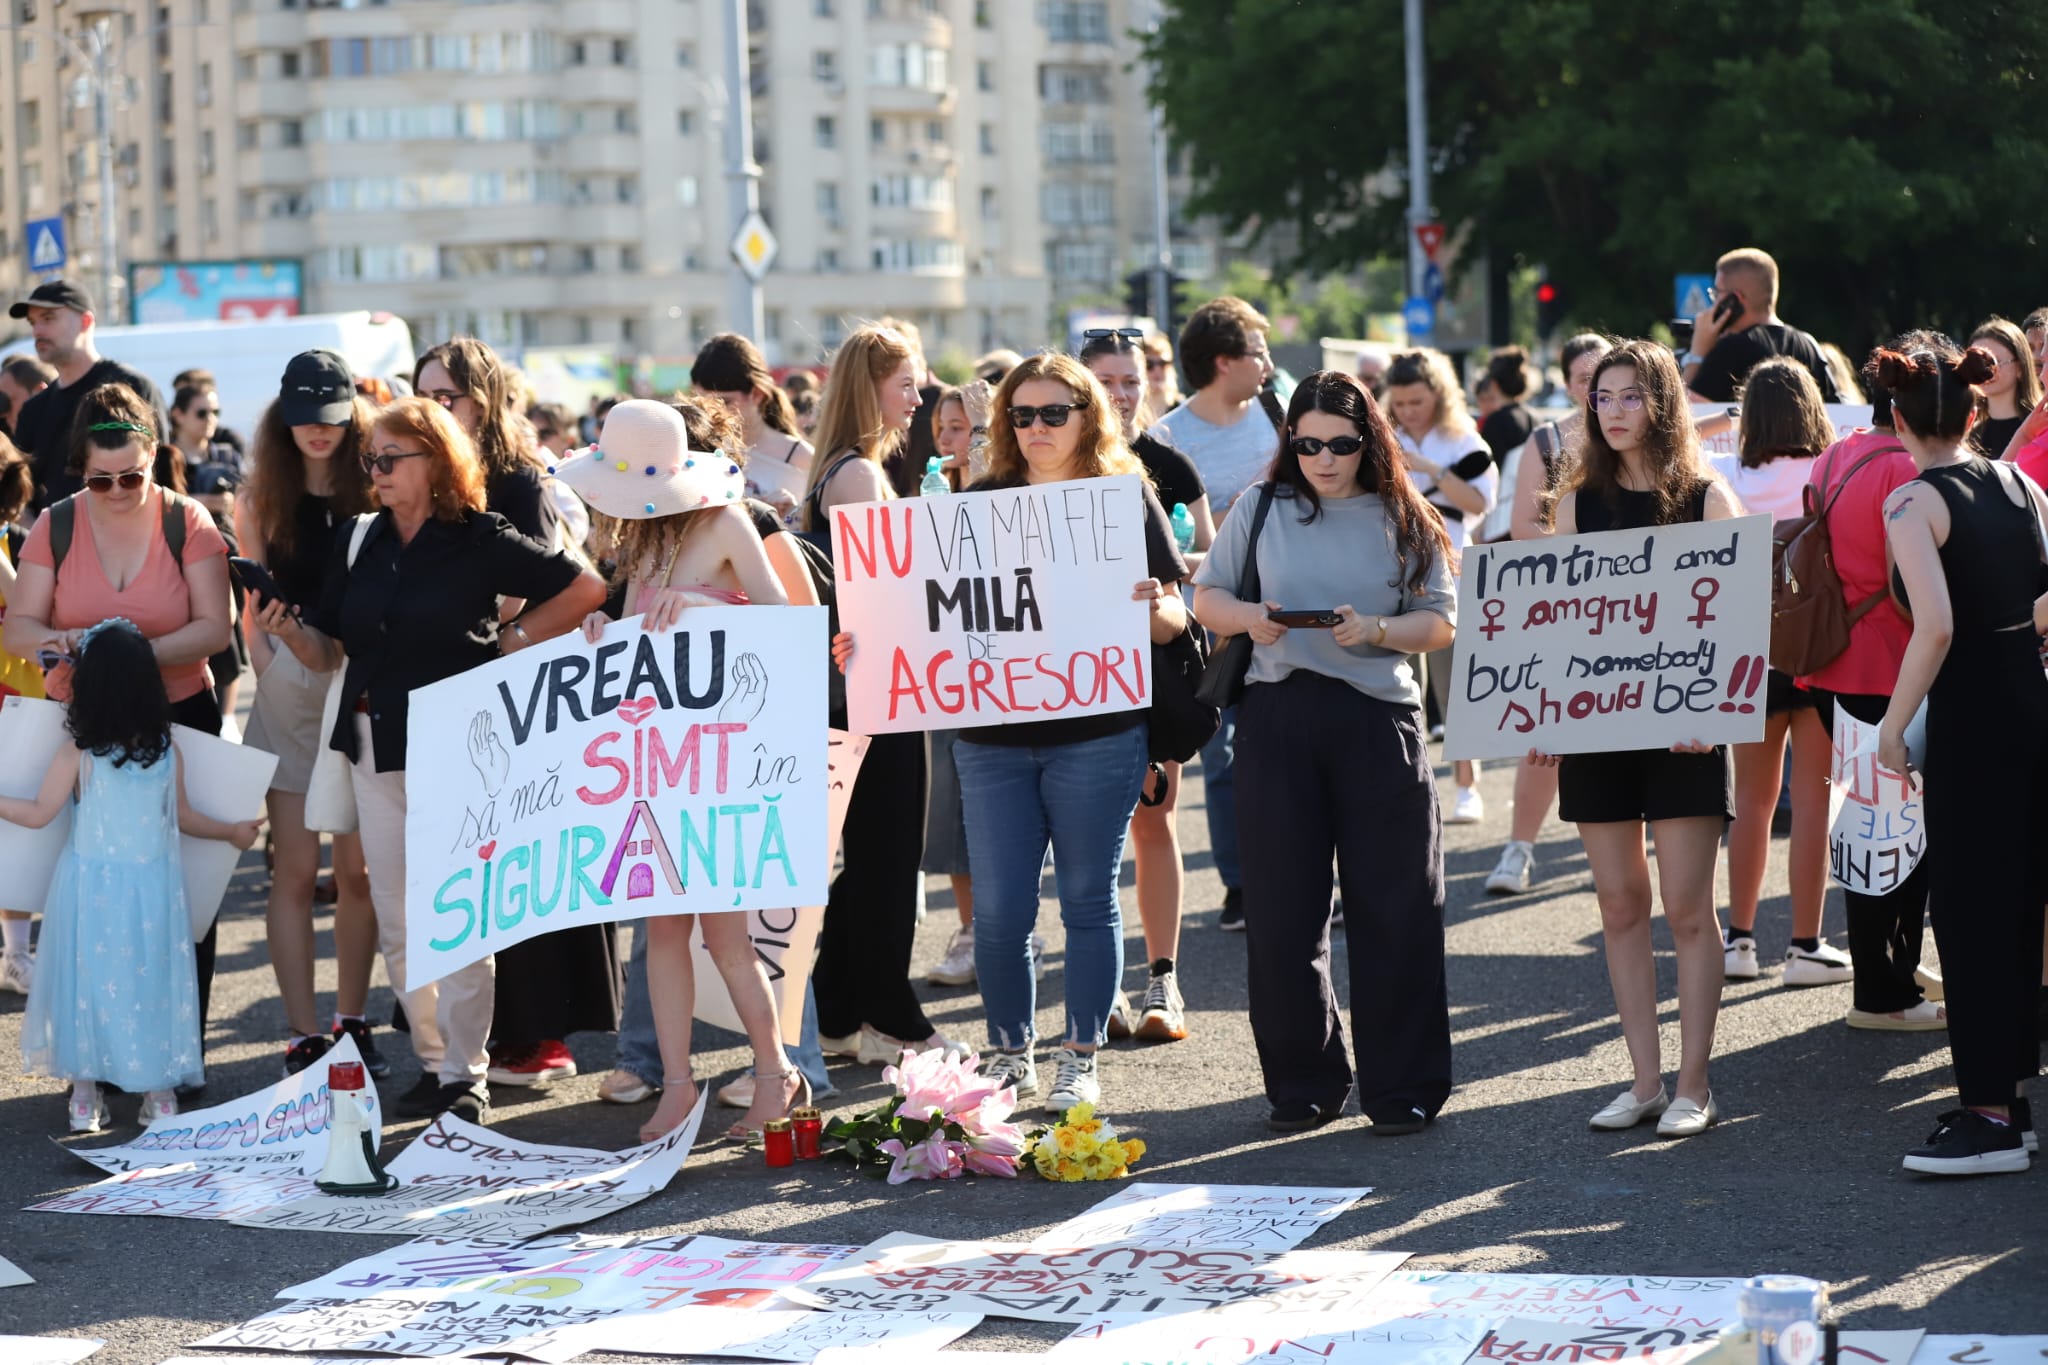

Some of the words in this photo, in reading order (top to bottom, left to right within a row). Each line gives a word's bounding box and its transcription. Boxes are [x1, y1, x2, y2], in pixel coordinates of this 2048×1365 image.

[837, 506, 912, 581] NU
[926, 501, 981, 572] VĂ
[990, 494, 1055, 567] MAI
[1063, 488, 1123, 565] FIE
[1562, 536, 1654, 586] tired
[1674, 532, 1739, 571] and
[925, 567, 1043, 632] MILĂ
[1522, 592, 1658, 635] angry
[966, 633, 1004, 661] DE
[1467, 653, 1542, 702] but
[1566, 639, 1716, 678] somebody
[497, 630, 725, 745] VREAU
[888, 645, 1146, 720] AGRESORI
[1498, 680, 1645, 733] should
[451, 793, 501, 854] să
[509, 760, 564, 823] mă
[576, 722, 748, 805] SIMT
[746, 743, 802, 788] în
[429, 793, 798, 952] SIGURANȚĂ
[336, 1273, 583, 1299] QUEER
[528, 1251, 825, 1282] FIGHT
[642, 1287, 778, 1309] BE
[812, 1296, 936, 1311] ESTE
[889, 1293, 951, 1302] CU
[1468, 1286, 1643, 1303] VREM
[1571, 1326, 1721, 1347] BUZ
